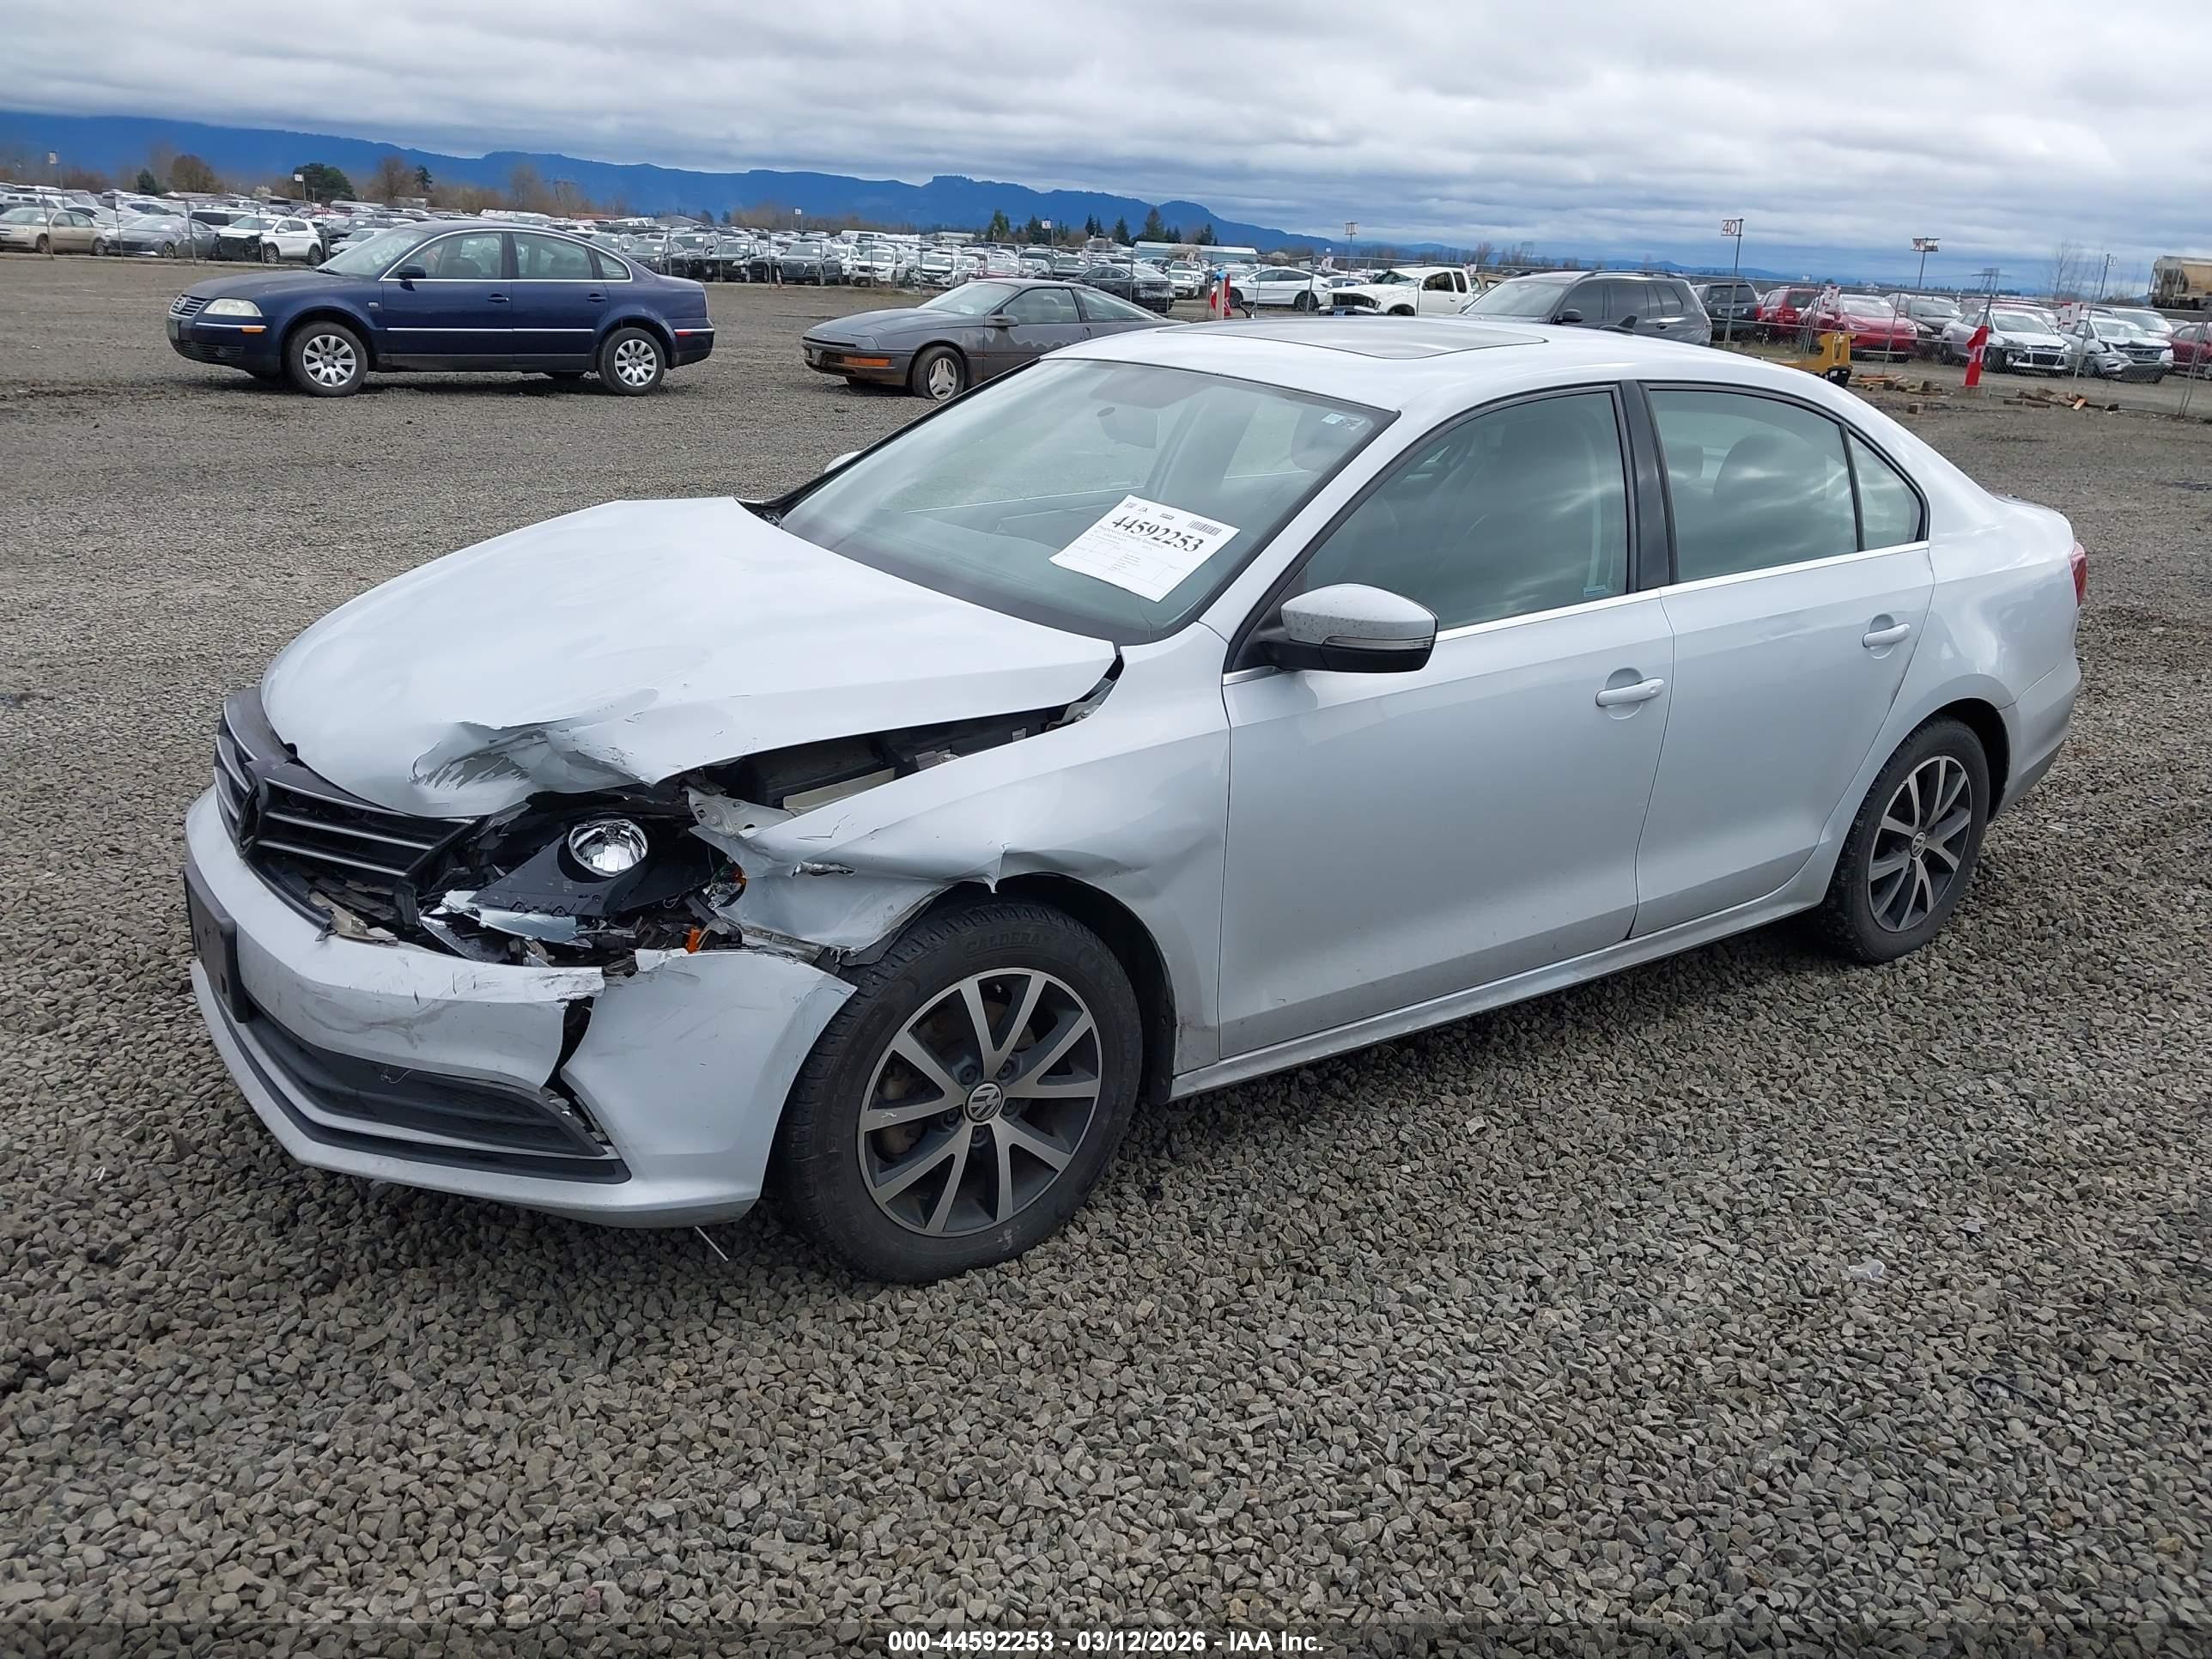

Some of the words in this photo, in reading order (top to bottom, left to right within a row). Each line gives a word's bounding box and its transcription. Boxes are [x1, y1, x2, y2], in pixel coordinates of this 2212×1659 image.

[1723, 219, 1737, 234] 40
[1828, 292, 1834, 301] 2
[1111, 515, 1204, 552] 44592253
